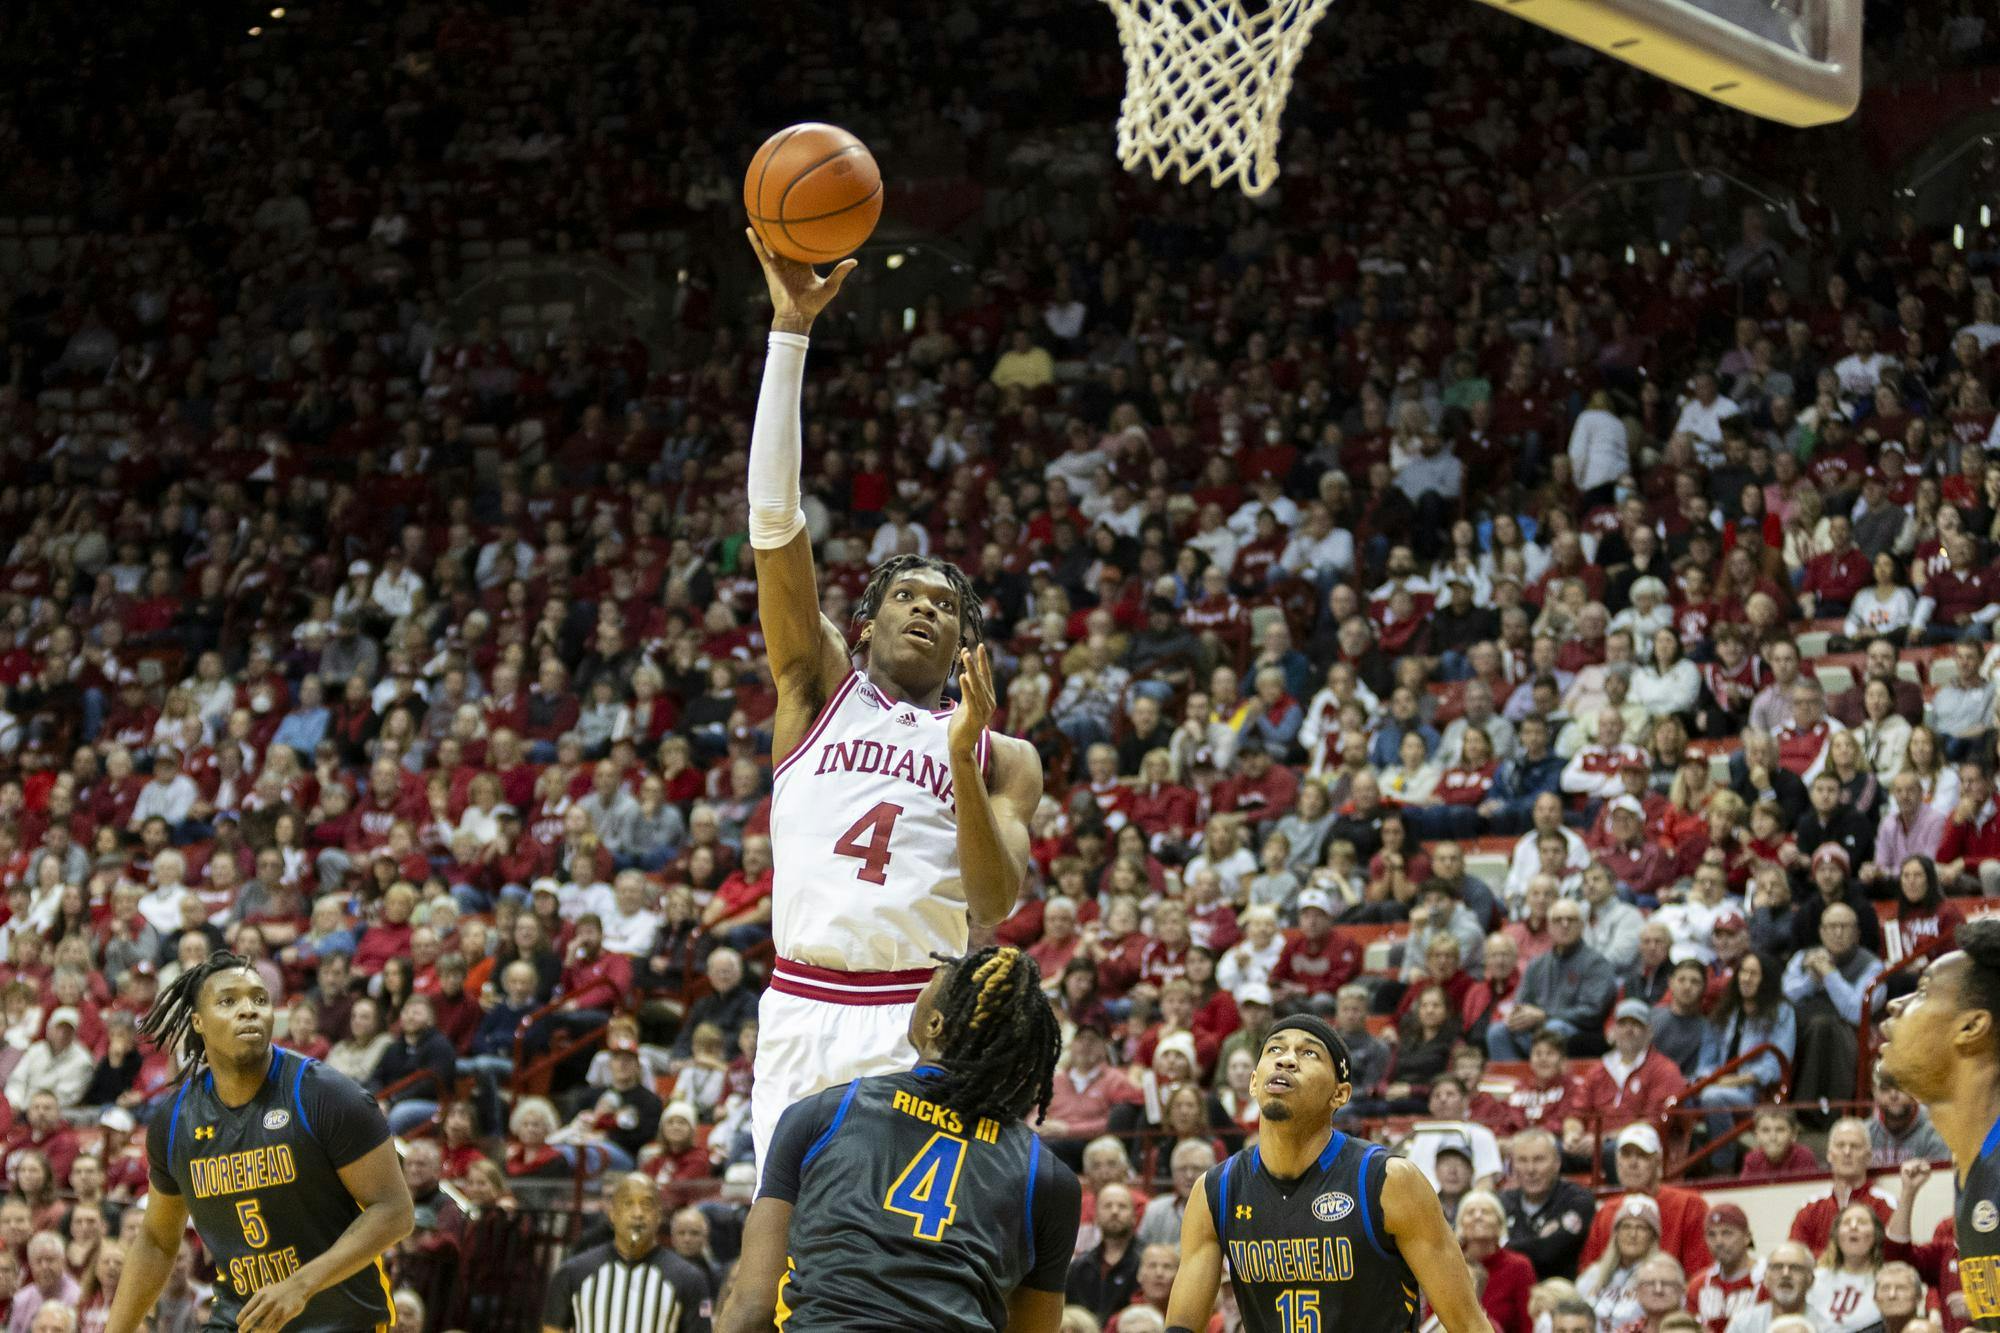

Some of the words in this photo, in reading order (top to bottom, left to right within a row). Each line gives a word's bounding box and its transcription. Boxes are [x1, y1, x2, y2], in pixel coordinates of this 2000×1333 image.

[833, 801, 904, 886] 4
[892, 1090, 964, 1134] RICKS
[975, 1116, 1000, 1145] III
[190, 1145, 296, 1198] MOREHEAD
[883, 1131, 968, 1242] 4
[235, 1199, 269, 1248] 5
[1229, 1238, 1354, 1283] MOREHEAD
[1275, 1289, 1321, 1333] 15
